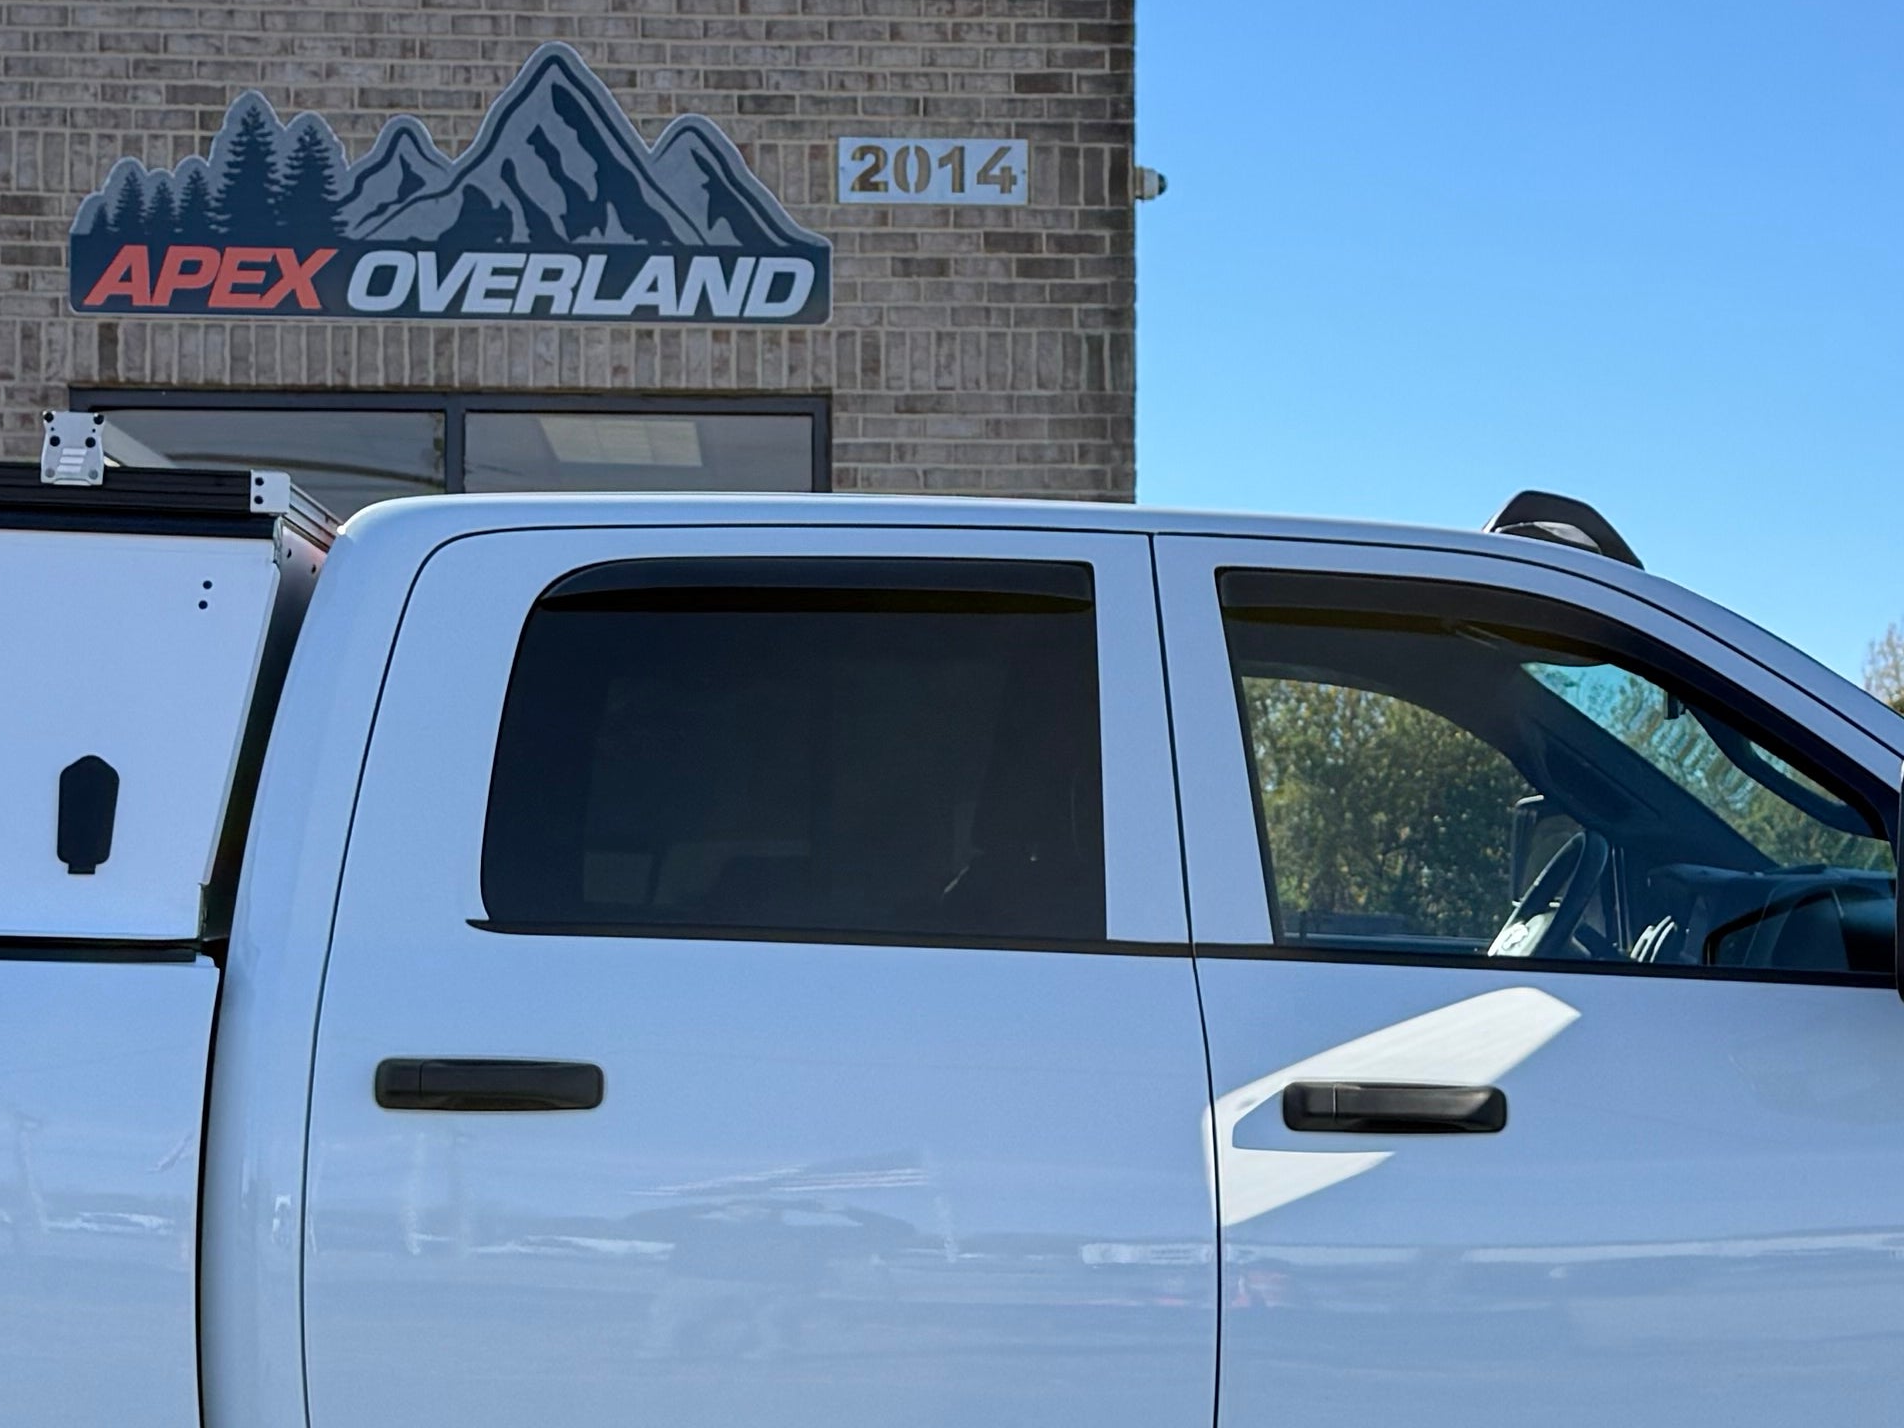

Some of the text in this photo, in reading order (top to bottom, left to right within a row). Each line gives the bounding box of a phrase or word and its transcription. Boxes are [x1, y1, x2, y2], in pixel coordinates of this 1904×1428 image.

[851, 144, 1017, 194] 2014
[82, 244, 815, 317] APEX OVERLAND
